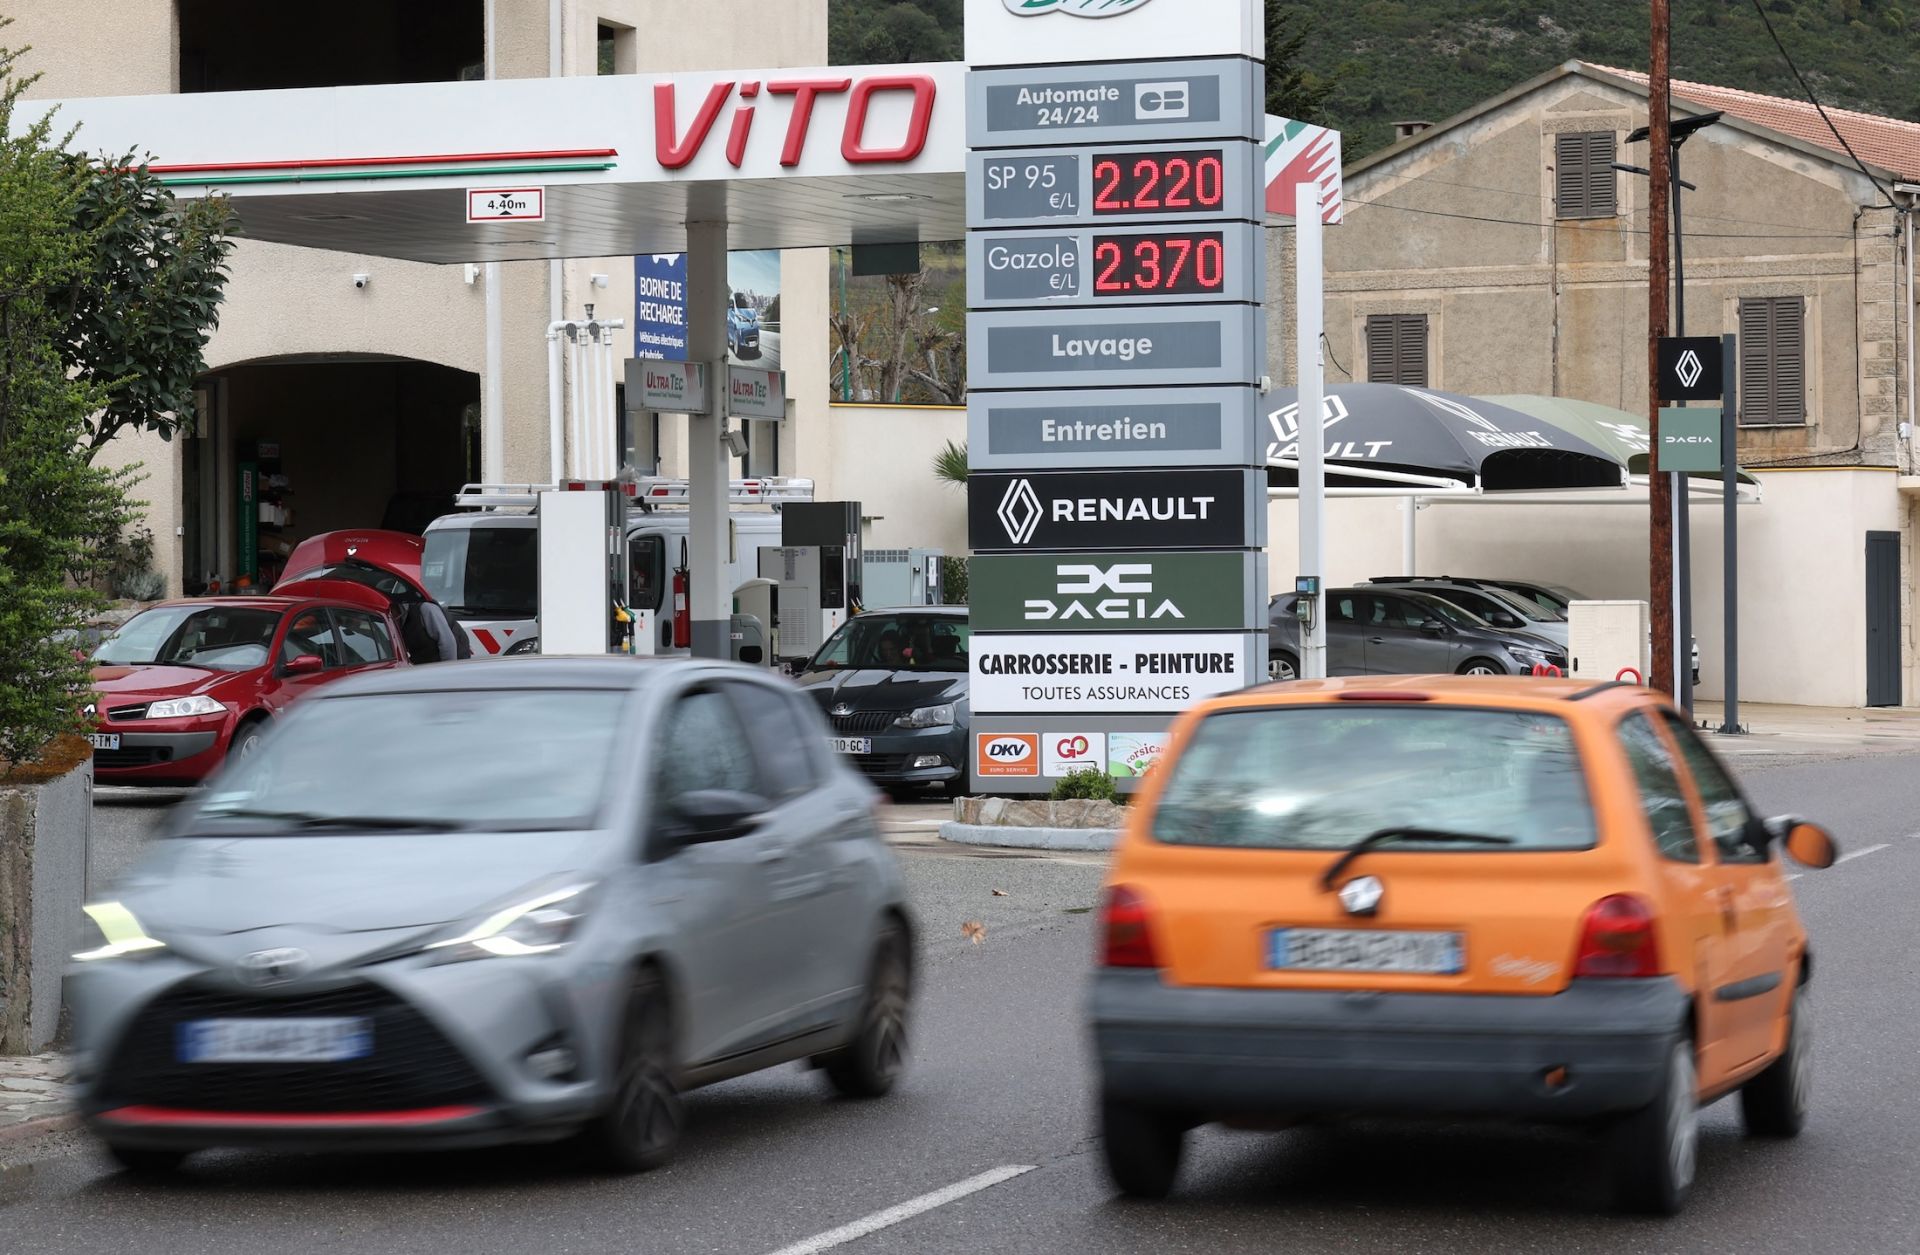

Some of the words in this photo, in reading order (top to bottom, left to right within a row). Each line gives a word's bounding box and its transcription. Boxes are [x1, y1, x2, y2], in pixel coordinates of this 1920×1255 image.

[1016, 86, 1120, 106] Automate
[1037, 105, 1099, 126] 24/24
[988, 166, 1016, 191] SP
[1025, 164, 1056, 189] 95
[1094, 157, 1222, 209] 2.220
[487, 199, 526, 210] 4.40m
[1049, 192, 1076, 209] €/L
[988, 244, 1075, 271] Gazole
[1095, 239, 1223, 291] 2.370
[640, 277, 670, 299] BORNE
[671, 282, 682, 301] DE
[1049, 273, 1076, 290] €/L
[640, 301, 683, 325] RECHARGE
[1052, 334, 1153, 361] Lavage
[1042, 417, 1167, 443] Entretien
[1466, 430, 1554, 447] RENAULT
[1053, 496, 1215, 522] RENAULT
[1024, 598, 1185, 620] DACIA
[978, 653, 1112, 675] CARROSSERIE
[1135, 652, 1235, 675] PEINTURE
[1022, 686, 1082, 701] TOUTES
[1087, 685, 1190, 700] ASSURANCES
[989, 744, 1025, 756] DKV
